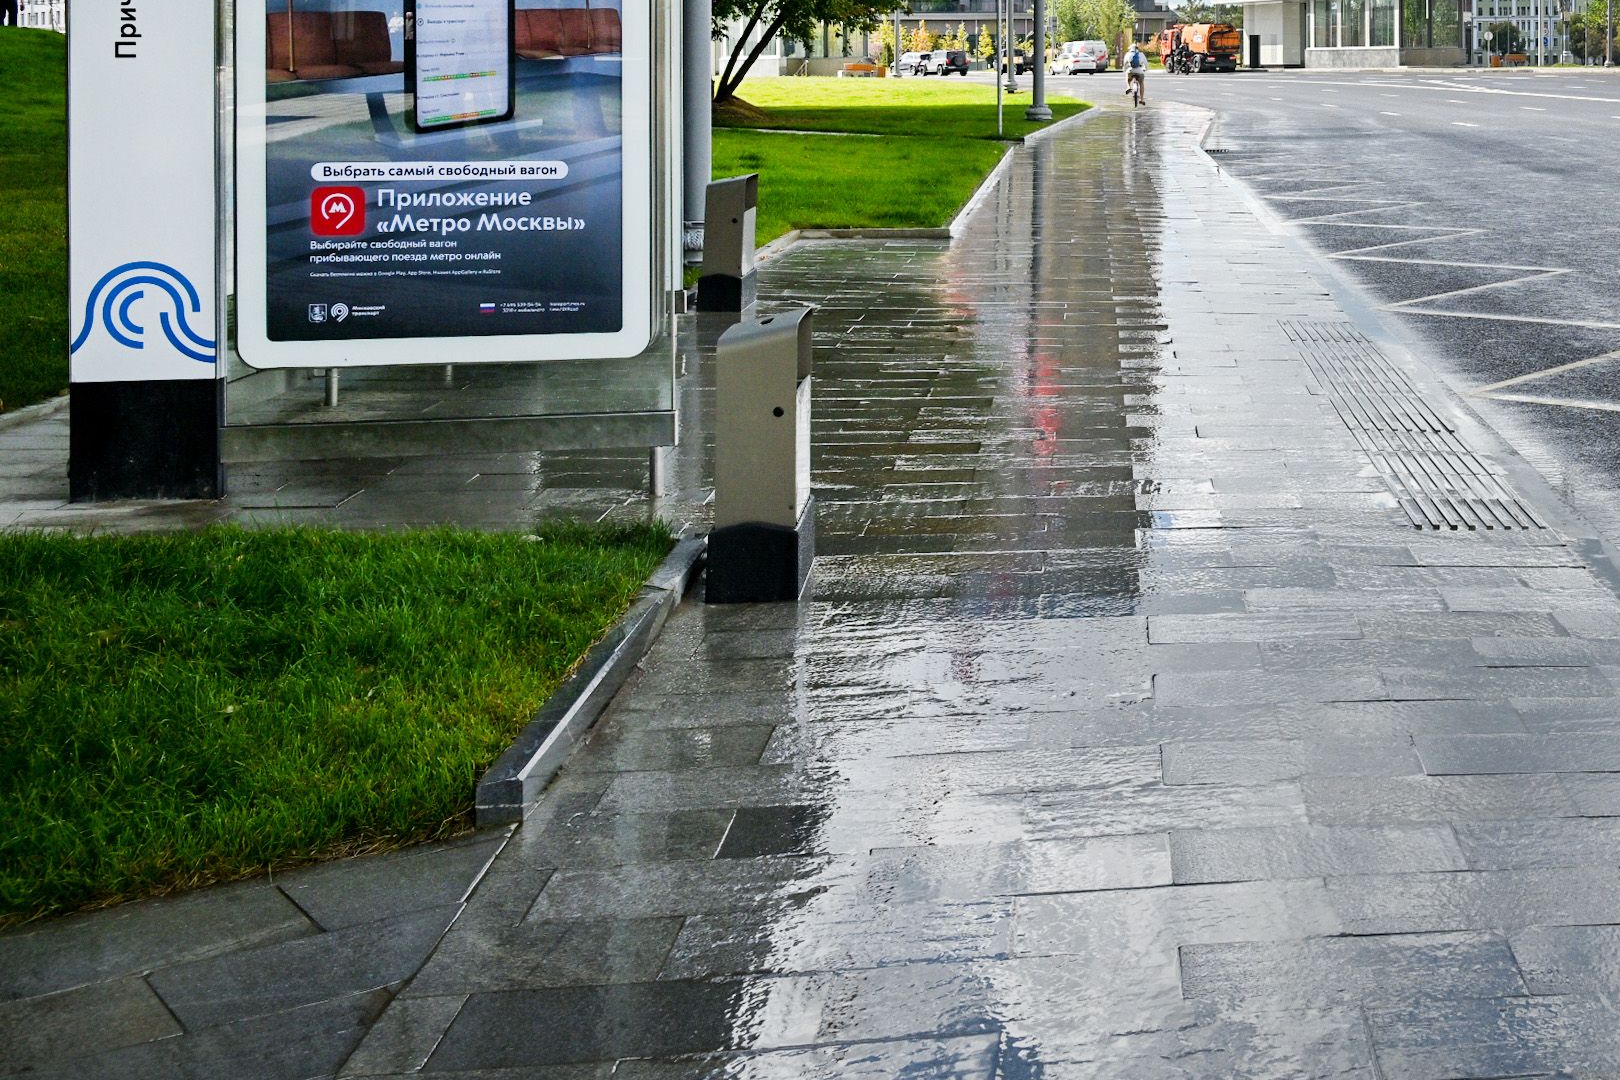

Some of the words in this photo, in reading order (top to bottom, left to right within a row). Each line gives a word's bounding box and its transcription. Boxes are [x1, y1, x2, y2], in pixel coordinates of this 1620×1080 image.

[323, 166, 385, 178] Выбрать
[388, 166, 434, 176] самый
[438, 165, 516, 176] свободный
[520, 167, 557, 175] вагон
[377, 189, 532, 211] Приложение
[376, 214, 471, 236] «Метро
[476, 213, 586, 232] Москвы»
[310, 240, 368, 251] Выбирайте
[370, 239, 427, 249] свободный
[309, 252, 389, 264] прибывающего
[392, 253, 428, 262] поезда
[430, 253, 463, 262] метро
[464, 251, 501, 260] онлайн
